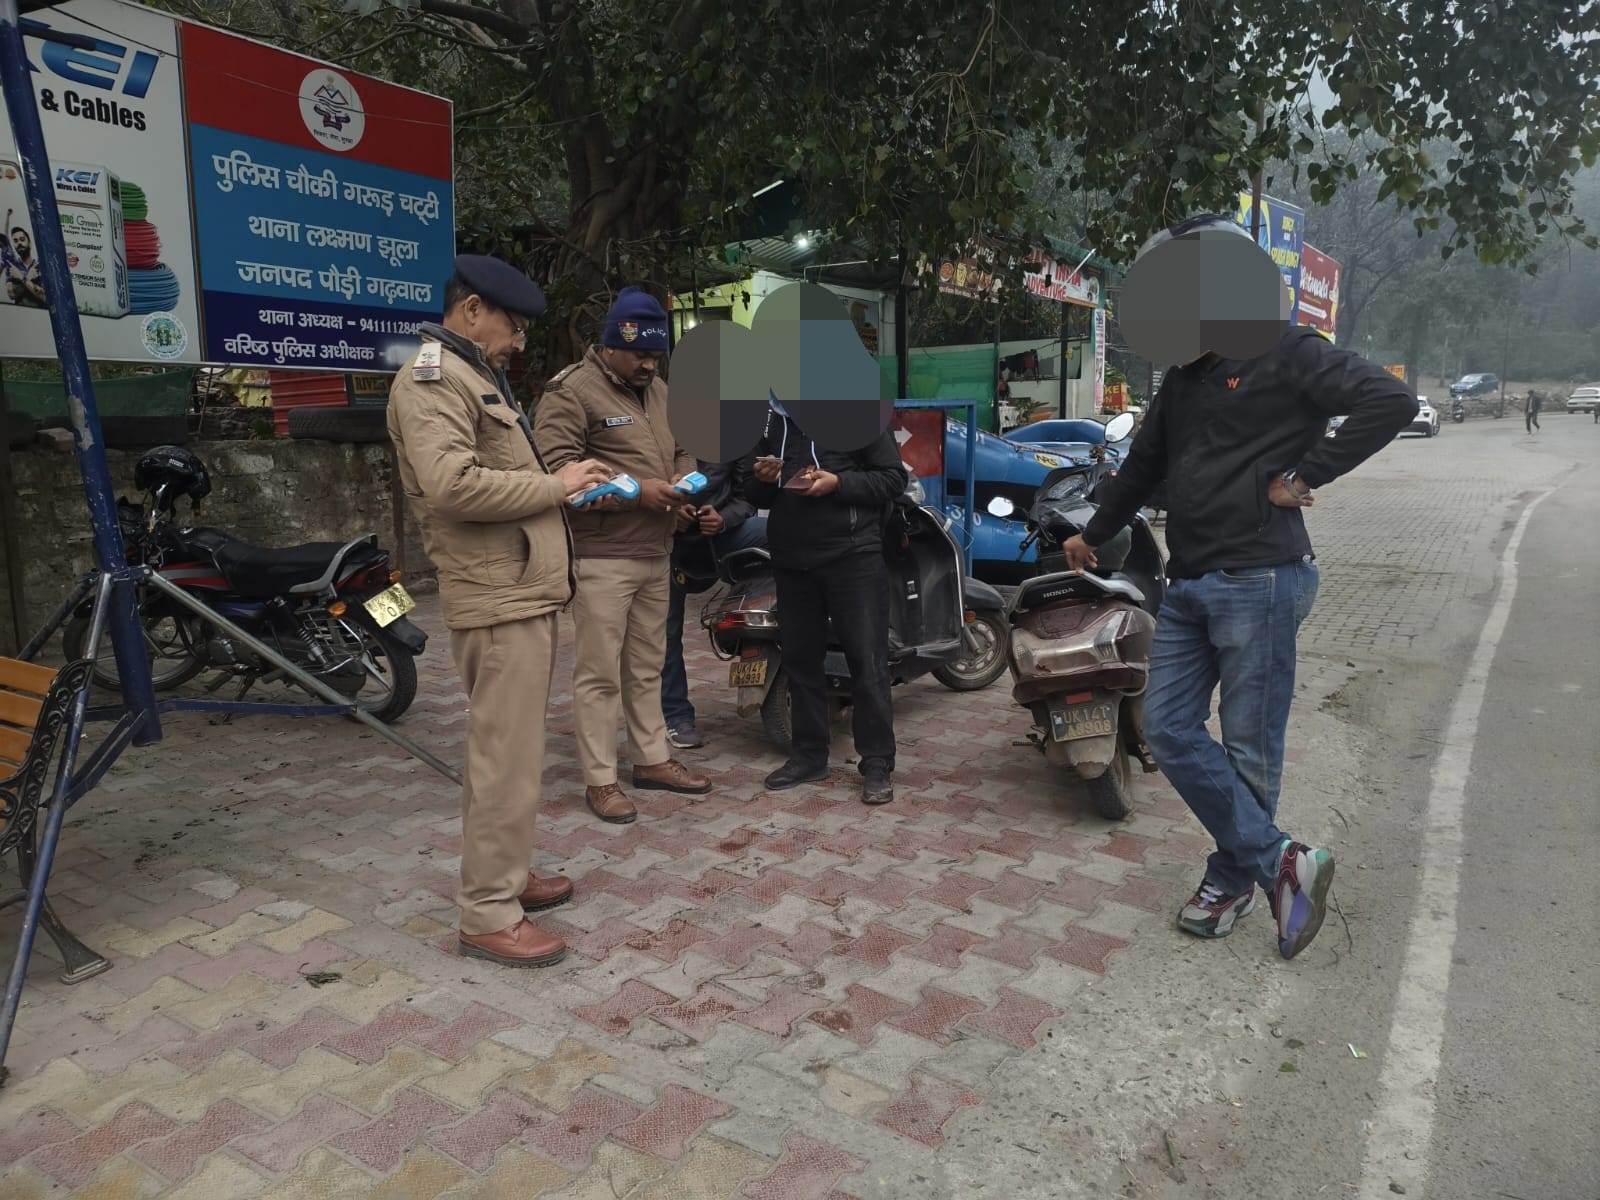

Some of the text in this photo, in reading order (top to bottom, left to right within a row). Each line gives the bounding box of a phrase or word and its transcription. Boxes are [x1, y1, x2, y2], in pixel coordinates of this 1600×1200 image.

[21, 17, 159, 99] EI
[40, 88, 146, 131] & Cables
[56, 168, 101, 186] KEI
[212, 150, 281, 193] पुलिस
[285, 164, 338, 200] चौकी
[248, 216, 419, 267] थाना लक्ष्मण झूला
[235, 260, 433, 304] जनपद पौड़ी गढ़वाल
[258, 309, 294, 326] थाना
[297, 312, 344, 330] अध्यक्ष
[223, 333, 269, 356] वरिष्ठ
[272, 336, 316, 364] पुलिस
[319, 339, 375, 361] अधीक्षक
[1104, 385, 1120, 394] KE
[1043, 587, 1075, 599] HONDA
